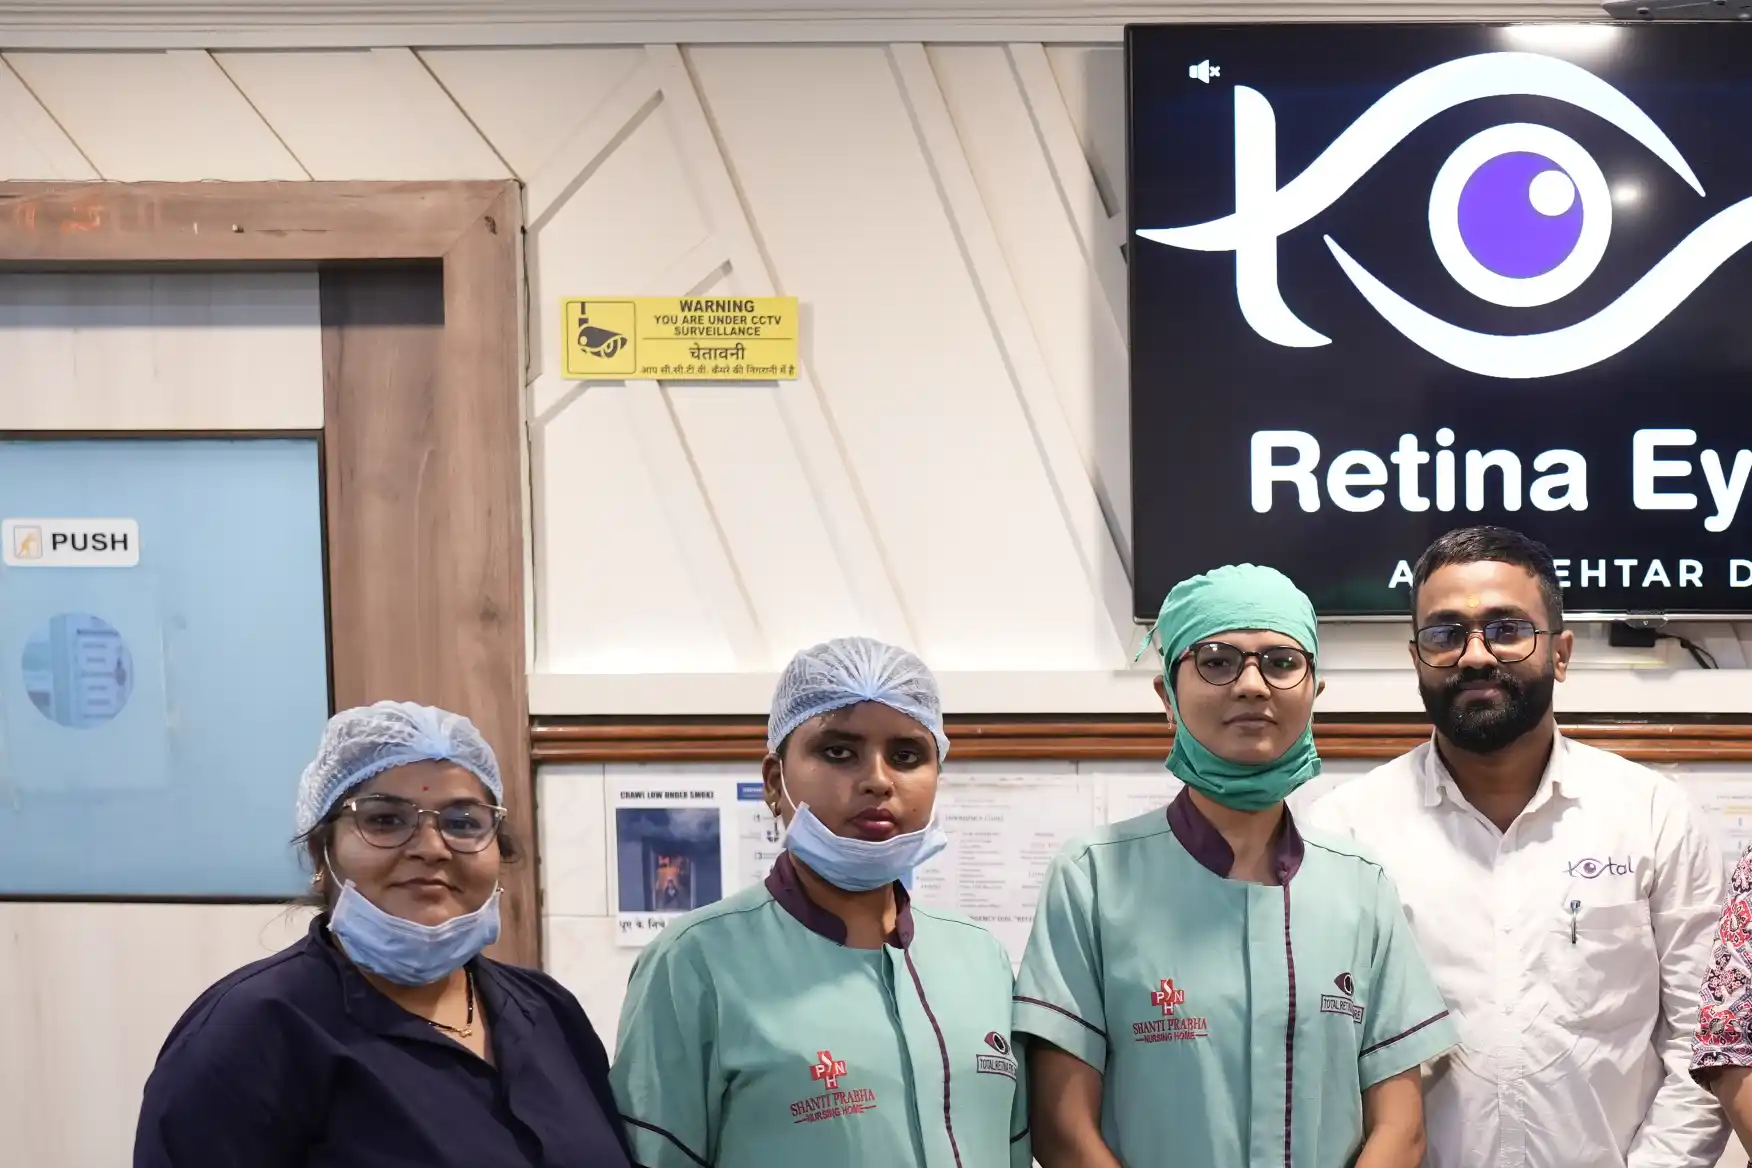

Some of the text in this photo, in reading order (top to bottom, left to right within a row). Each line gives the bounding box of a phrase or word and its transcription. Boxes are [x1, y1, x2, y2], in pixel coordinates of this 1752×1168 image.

[679, 300, 755, 313] WARNING
[654, 315, 782, 325] YOU ARE UNDER CCTV
[674, 326, 761, 336] SURVEILLANCE
[688, 342, 747, 361] चेतावनी
[1250, 427, 1589, 513] Retina
[52, 532, 129, 551] PUSH
[1556, 558, 1704, 588] EHTAR
[1323, 998, 1339, 1010] TOTAL
[1133, 1016, 1208, 1035] SHANTI PRABHA
[1144, 1031, 1195, 1043] NURSING HOME
[979, 1058, 995, 1071] TOTAL
[790, 1088, 876, 1117] SHANTI PRABHA
[804, 1104, 864, 1123] NURSING HOME
